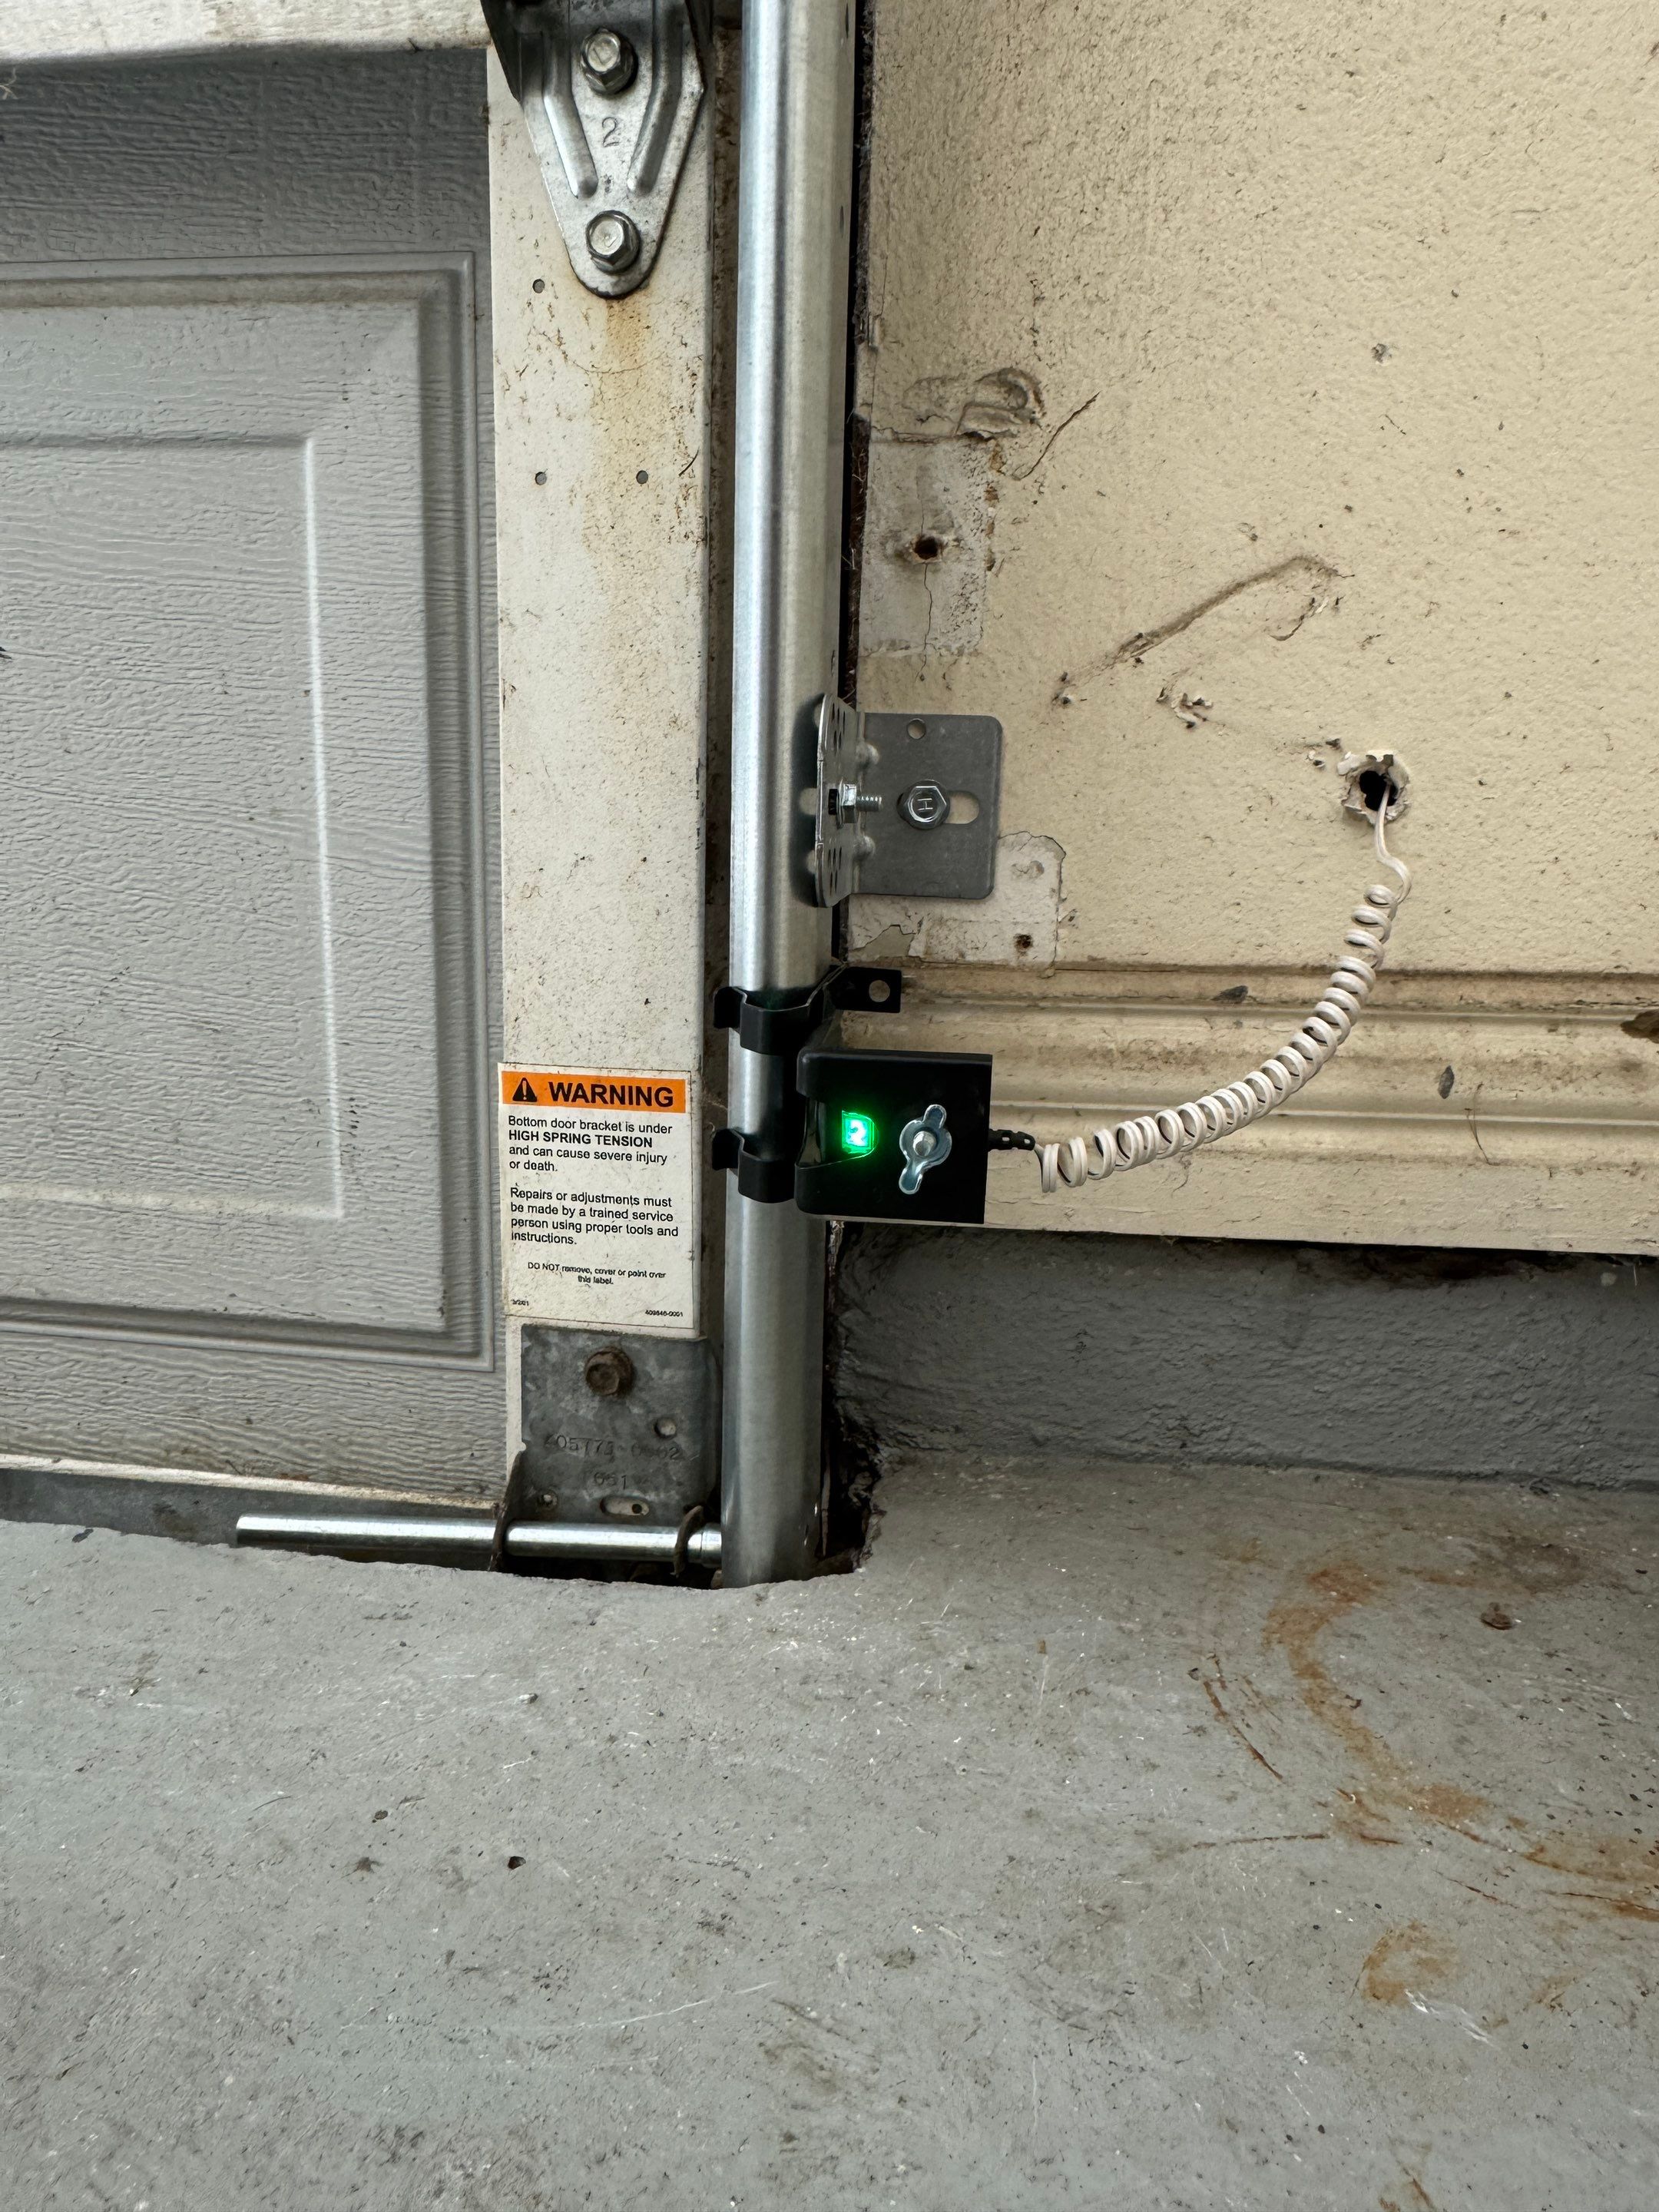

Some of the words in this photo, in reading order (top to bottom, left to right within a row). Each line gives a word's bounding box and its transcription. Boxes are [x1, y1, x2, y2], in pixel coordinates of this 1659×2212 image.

[601, 116, 621, 147] 2
[548, 1081, 674, 1108] WARNING
[508, 1115, 548, 1128] Bottom
[551, 1118, 577, 1129] door
[580, 1119, 622, 1132] bracket
[625, 1121, 635, 1132] is
[638, 1123, 673, 1134] under
[508, 1129, 539, 1141] HIGH
[543, 1131, 591, 1144] SPRING
[594, 1134, 653, 1147] TENSION
[509, 1145, 529, 1155] and
[533, 1147, 553, 1157] can
[556, 1149, 591, 1159] cause
[594, 1151, 633, 1161] severe
[636, 1151, 667, 1165] injury
[509, 1161, 520, 1169] or
[523, 1160, 558, 1172] death.
[510, 1187, 553, 1201] Repairs
[556, 1192, 568, 1200] or
[571, 1192, 640, 1205] adjustments
[644, 1197, 672, 1207] must
[511, 1201, 524, 1213] be
[528, 1204, 558, 1215] made
[561, 1205, 576, 1218] by
[579, 1208, 586, 1217] a
[589, 1207, 628, 1219] trained
[632, 1210, 674, 1222] service
[511, 1217, 548, 1229] person
[552, 1219, 581, 1233] using
[585, 1223, 623, 1235] proper
[626, 1224, 654, 1236] tools
[657, 1226, 679, 1237] and
[511, 1230, 577, 1245] instructions.
[542, 1263, 560, 1271] NOT
